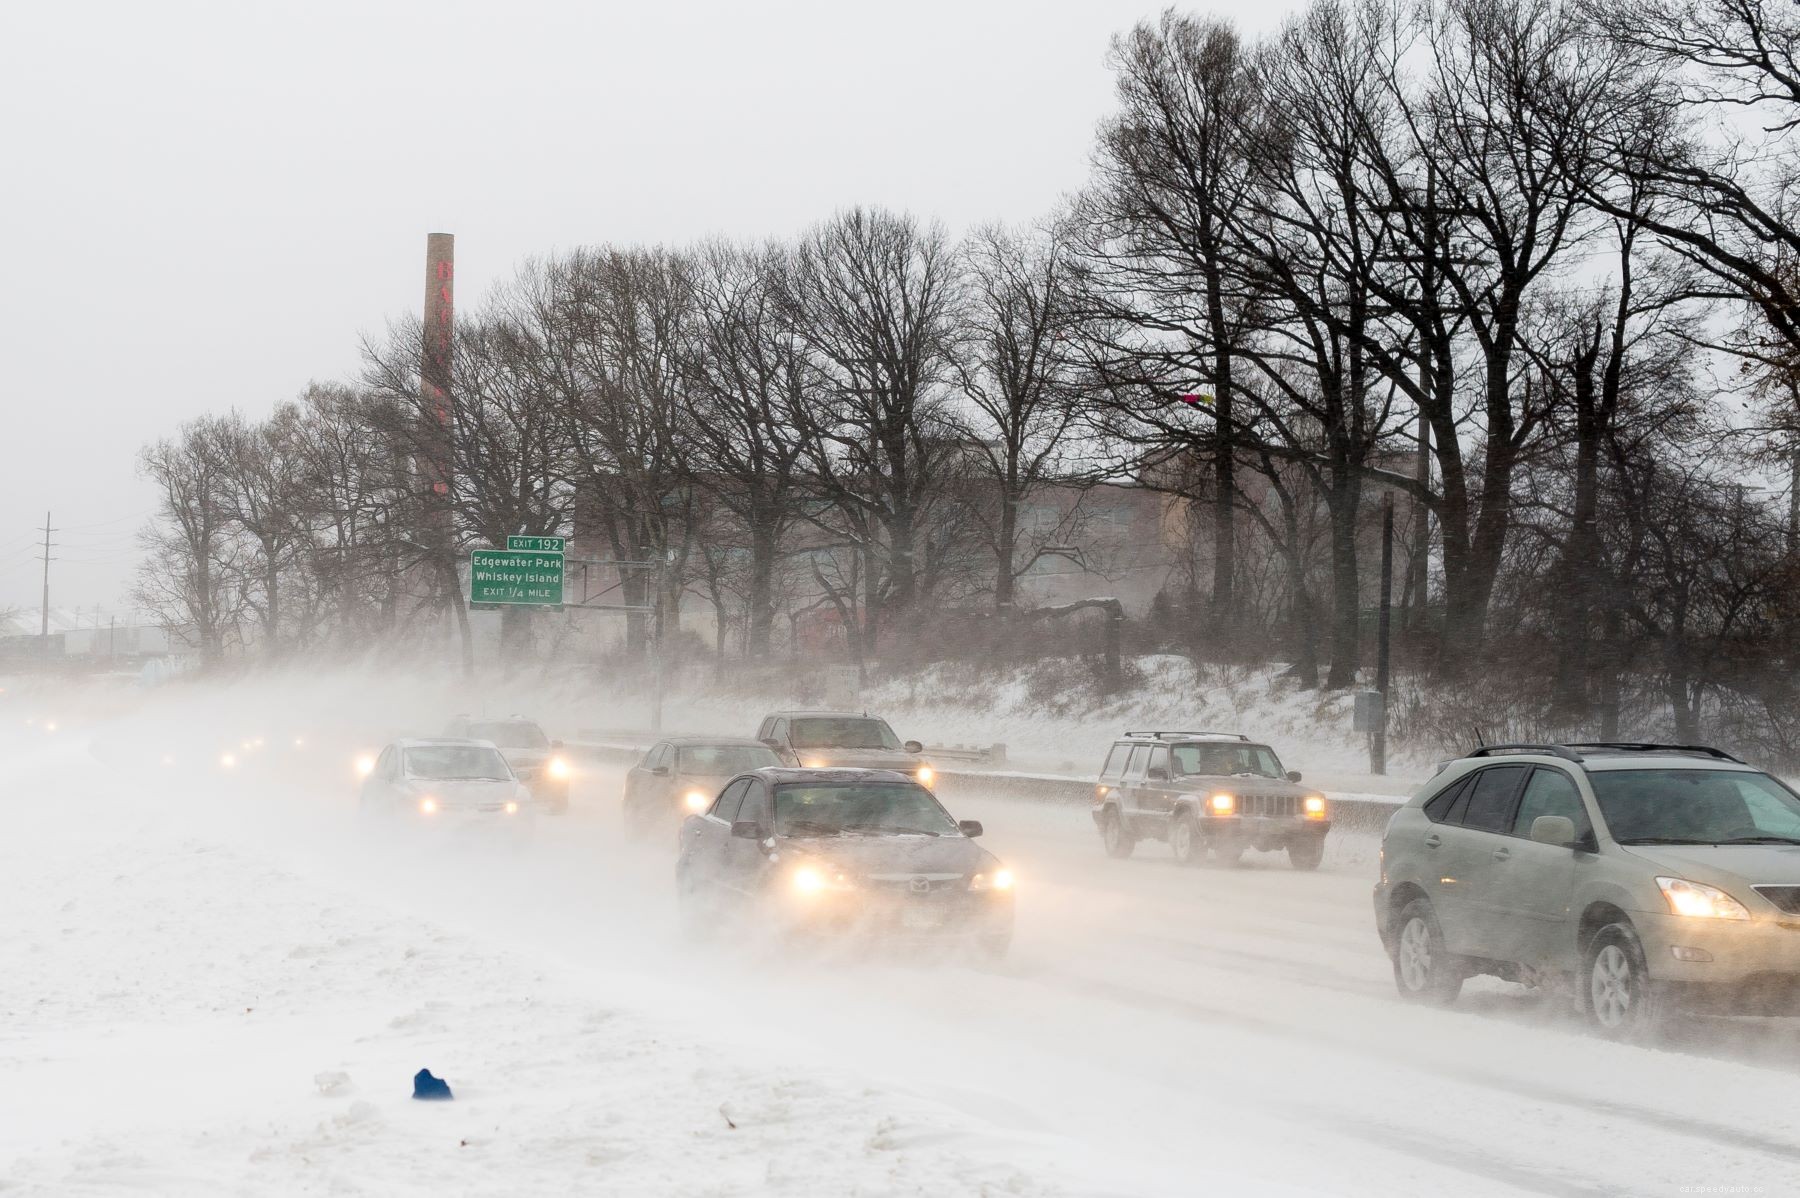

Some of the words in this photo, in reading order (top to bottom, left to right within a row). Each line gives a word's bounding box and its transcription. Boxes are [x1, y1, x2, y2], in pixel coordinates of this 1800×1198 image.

[513, 540, 532, 548] EXIT
[538, 539, 559, 550] 192
[474, 557, 532, 568] Edgewater
[536, 559, 561, 568] Park
[477, 572, 522, 584] Whiskey
[526, 573, 559, 583] Island
[528, 589, 550, 597] MILE
